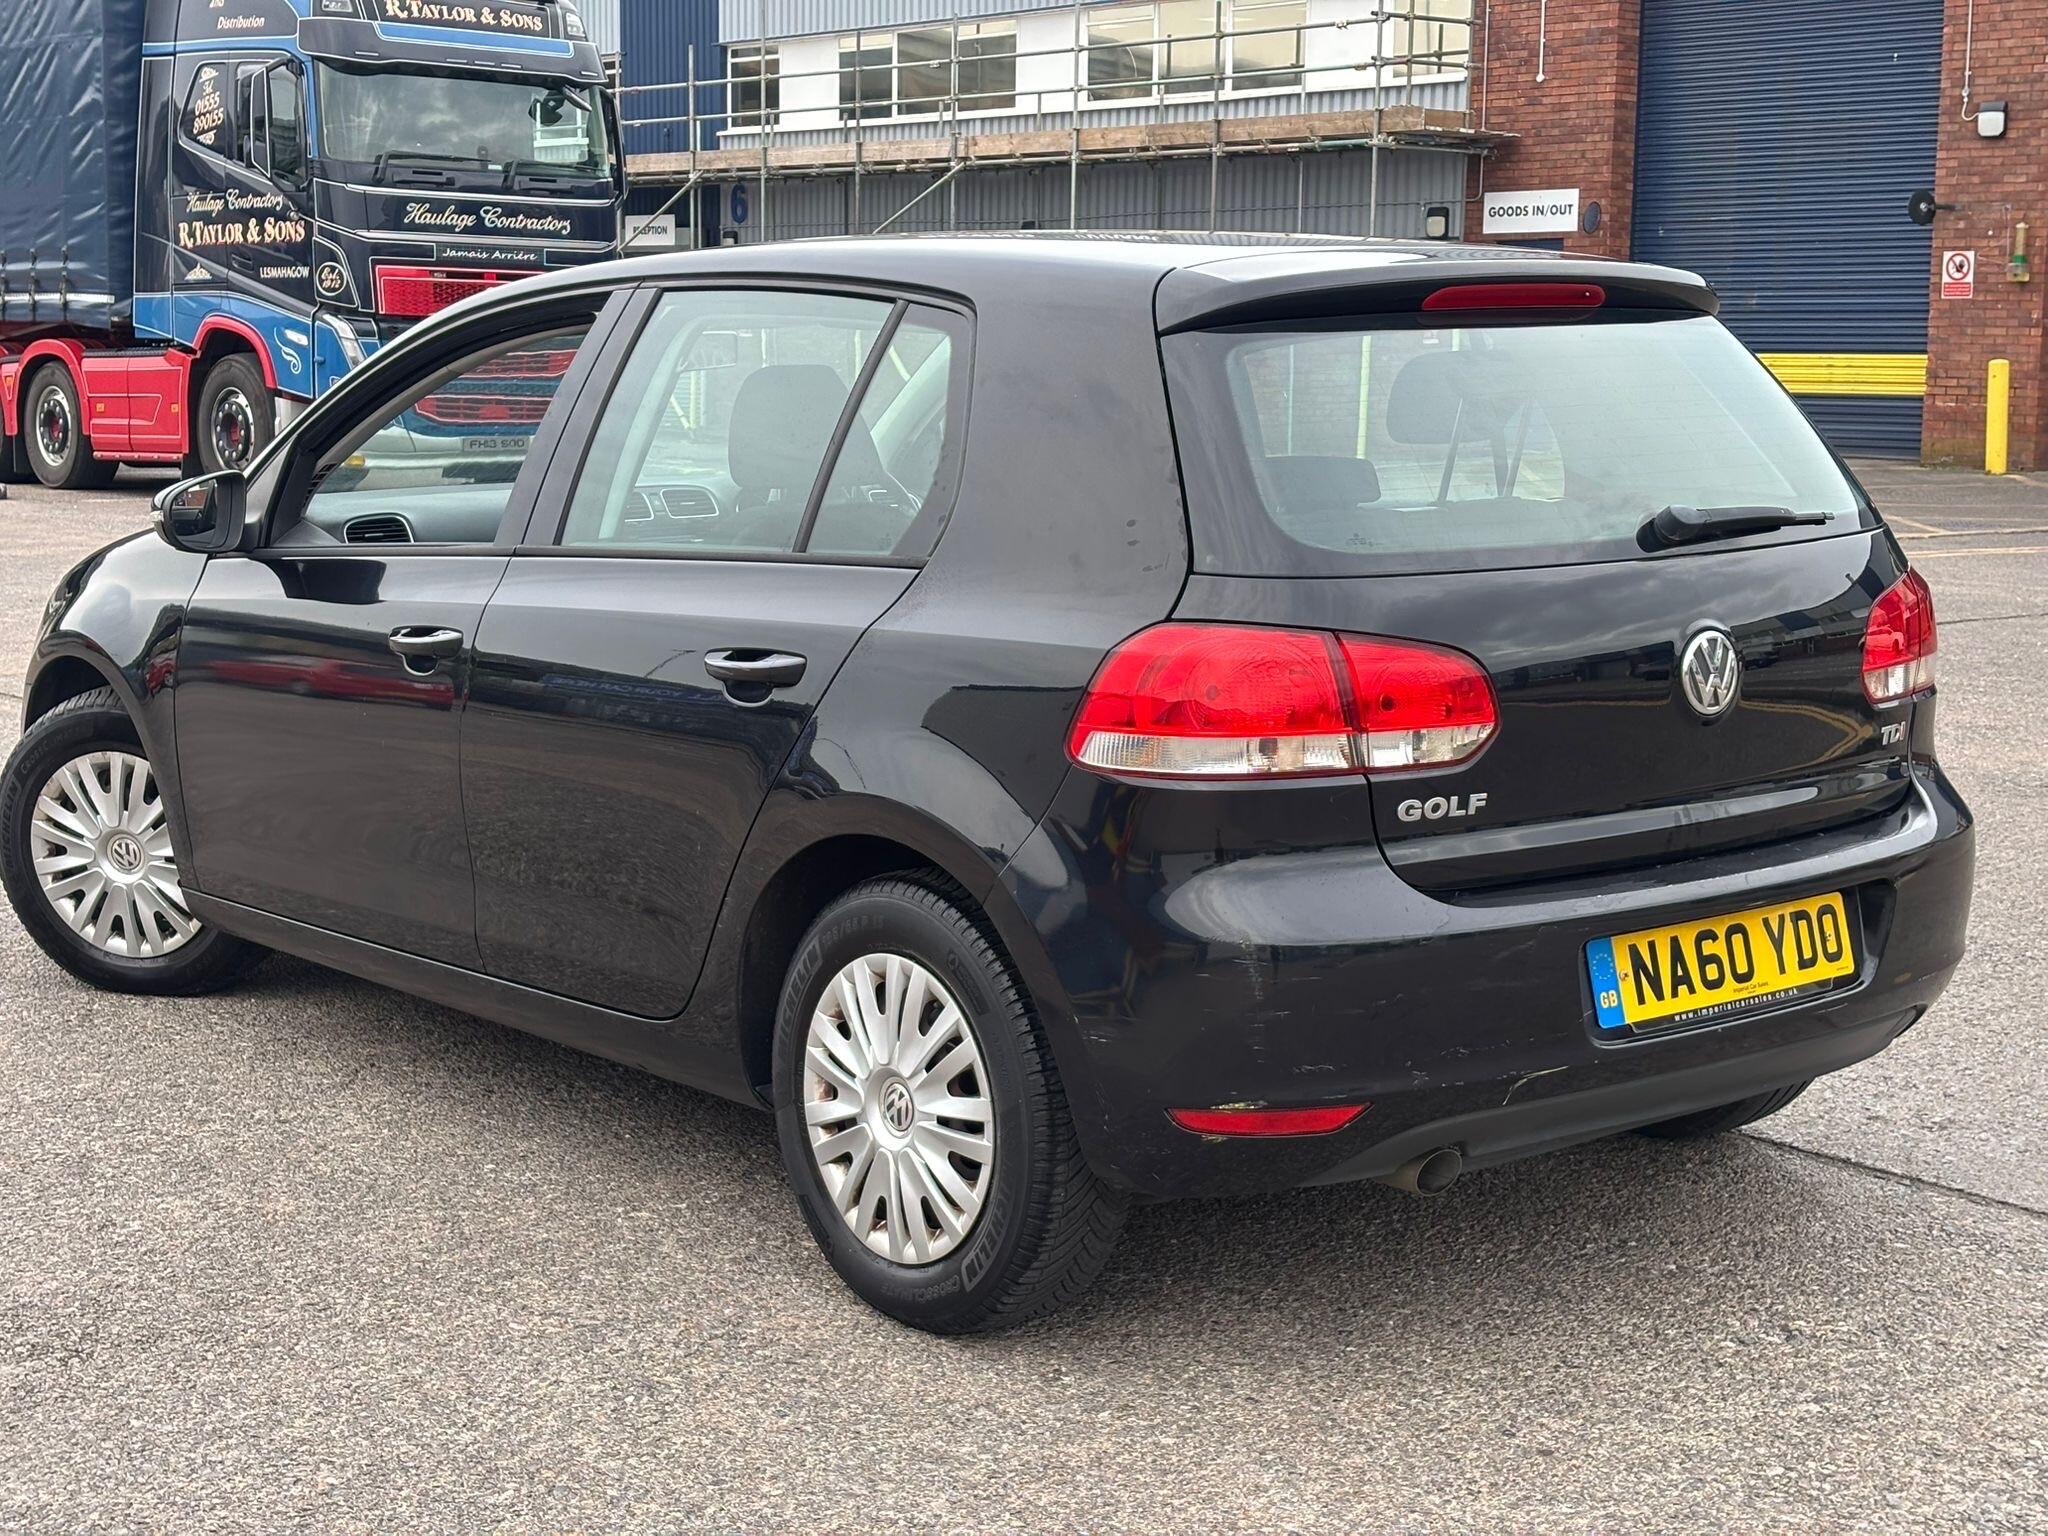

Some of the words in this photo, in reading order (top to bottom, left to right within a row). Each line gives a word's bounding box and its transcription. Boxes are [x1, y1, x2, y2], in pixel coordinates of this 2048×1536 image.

[216, 15, 266, 30] Distribution
[480, 6, 498, 26] &
[500, 10, 543, 32] SONS
[194, 91, 220, 116] 01555
[193, 107, 224, 134] 890155
[186, 191, 225, 217] Haulage
[225, 188, 284, 211] Contractors
[731, 183, 749, 224] 6
[1488, 205, 1529, 217] GOODS
[1532, 203, 1574, 216] IN/OUT
[246, 217, 262, 244] &
[263, 216, 306, 244] SONS
[403, 203, 477, 232] Haulage
[479, 206, 571, 235] Contractors
[442, 248, 490, 259] Jamais
[259, 266, 310, 279] LESMAHAGOW
[322, 279, 341, 289] 1912
[1881, 721, 1906, 746] TDI
[1397, 793, 1488, 822] GOLF
[1628, 922, 1756, 1006] NA60
[1762, 903, 1844, 976] YDO
[1600, 989, 1619, 1009] GB
[1674, 988, 1799, 1021] www.imperialcarsales.co.uk
